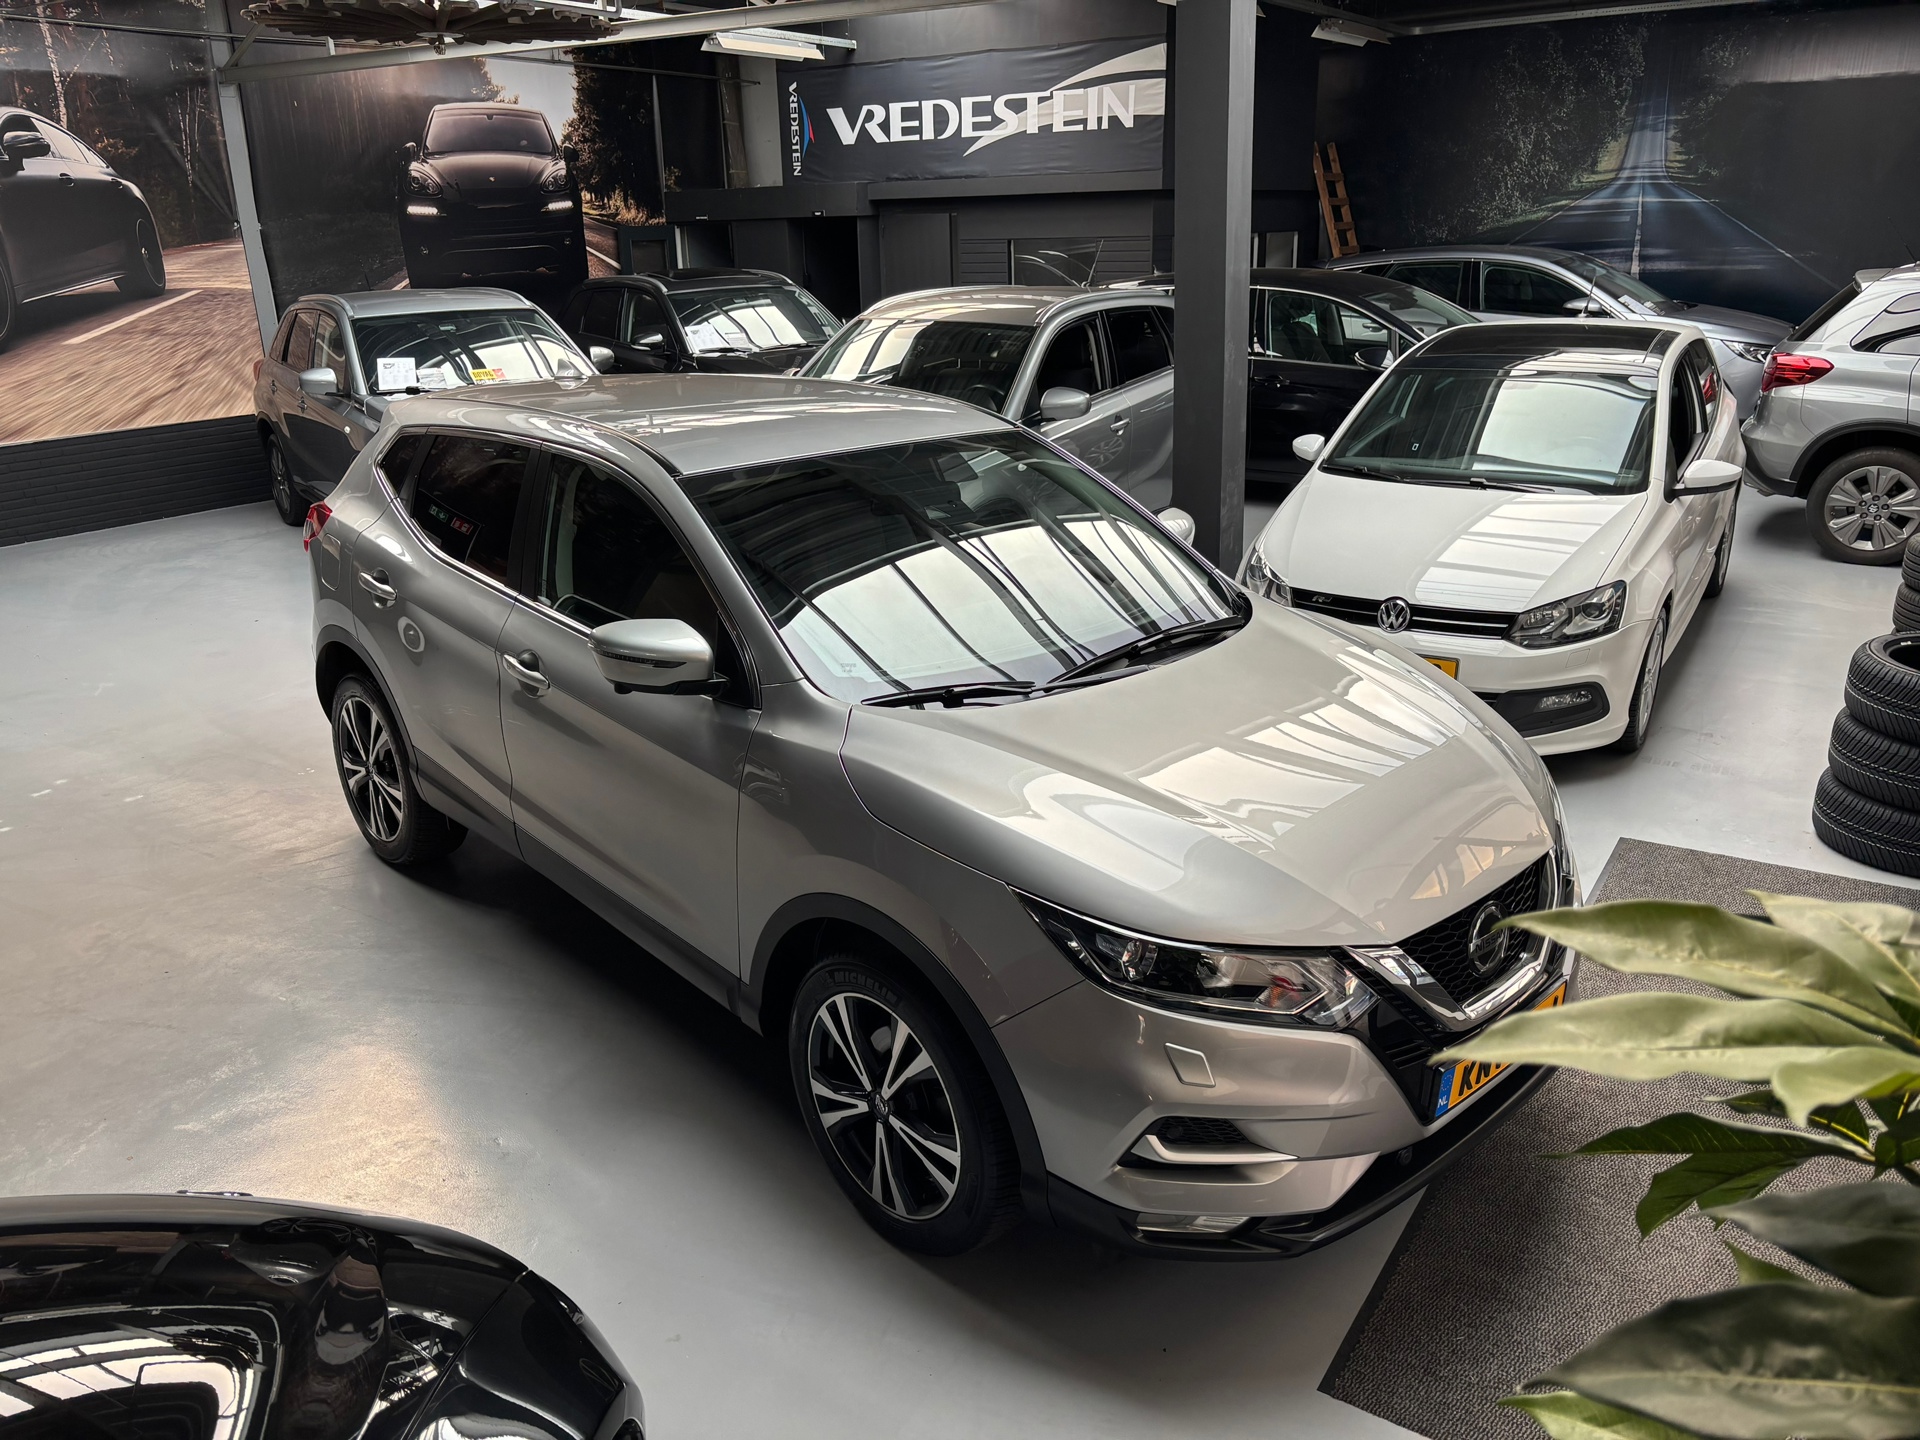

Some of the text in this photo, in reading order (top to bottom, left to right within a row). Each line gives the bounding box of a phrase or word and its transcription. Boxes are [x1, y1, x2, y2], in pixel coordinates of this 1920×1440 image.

[788, 81, 802, 176] VREDESTEIN
[825, 84, 1136, 147] VREDESTEIN
[833, 971, 898, 1004] MICHELIN
[1437, 1095, 1448, 1108] NL
